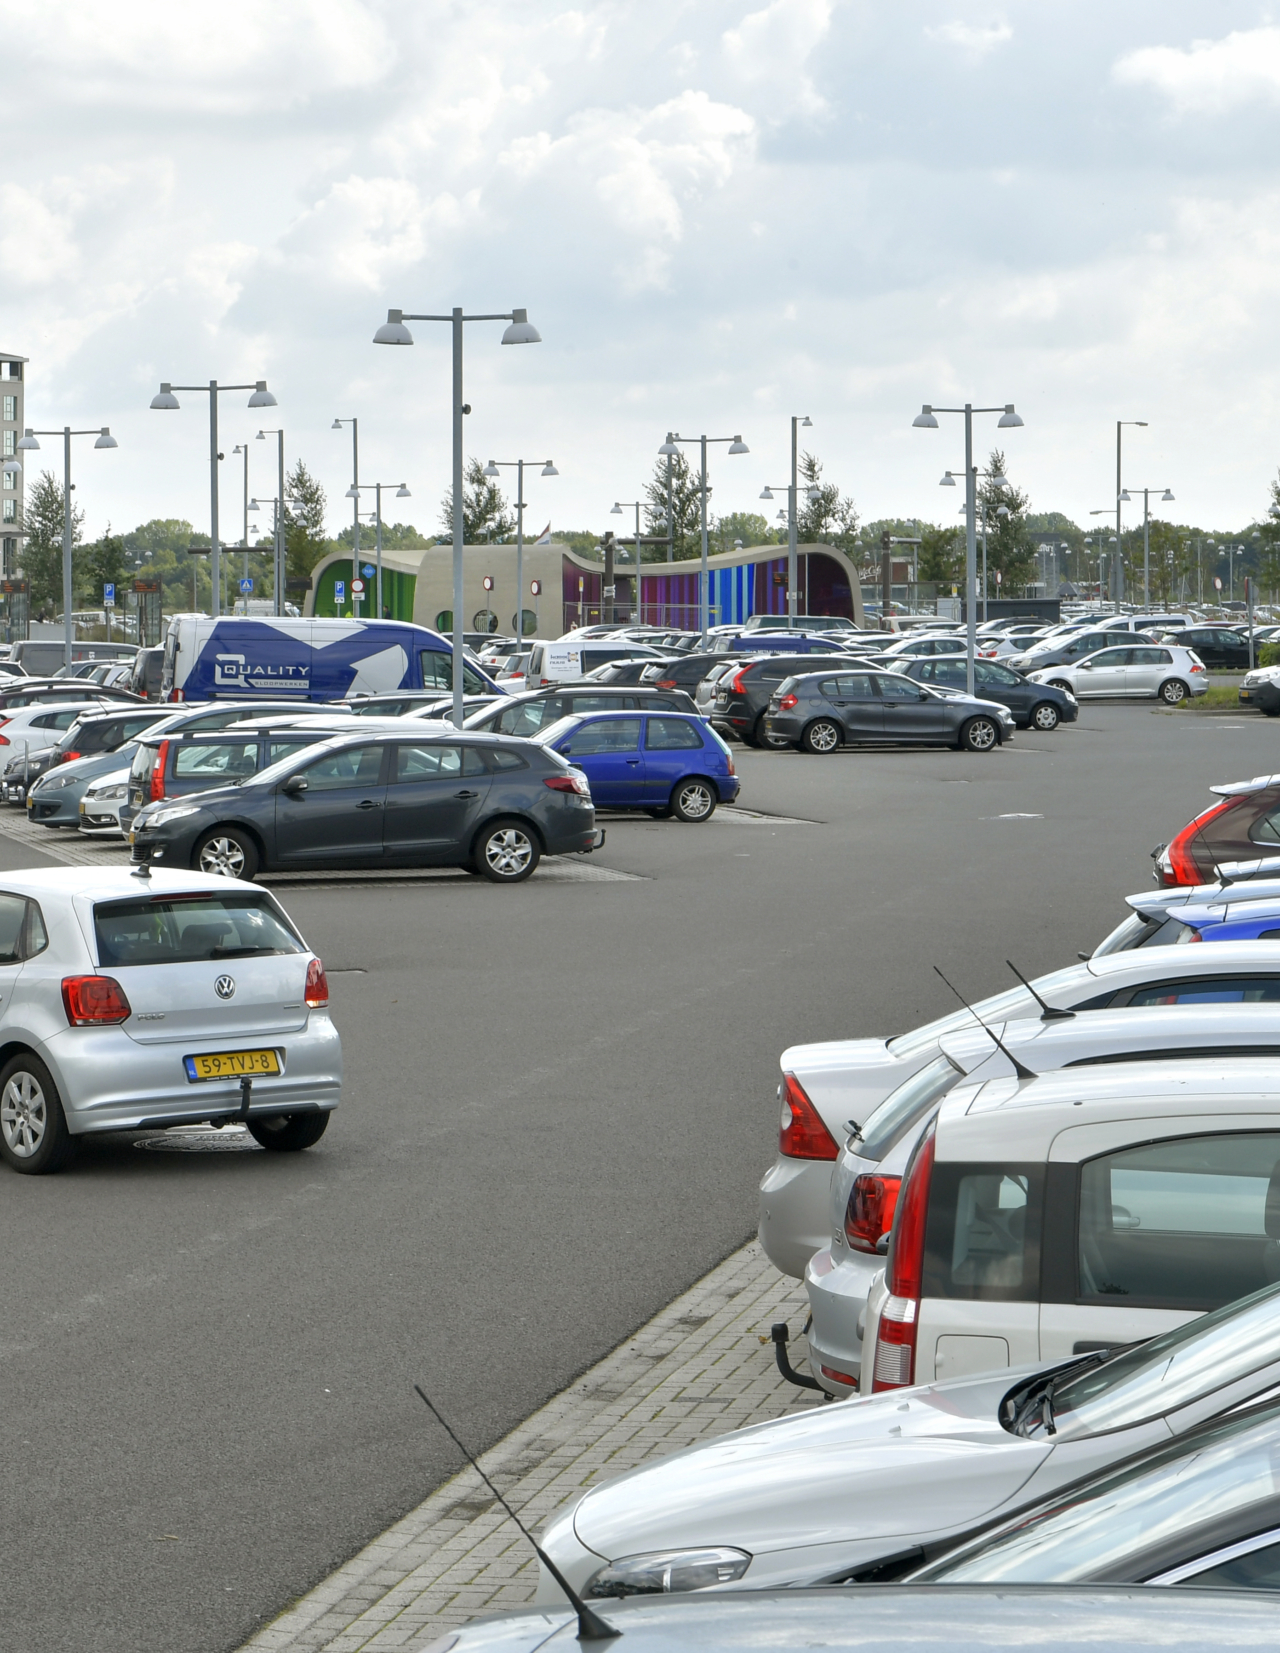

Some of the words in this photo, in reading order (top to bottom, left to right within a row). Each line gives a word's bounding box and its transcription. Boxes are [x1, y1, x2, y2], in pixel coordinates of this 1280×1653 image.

[106, 585, 112, 594] P
[336, 582, 342, 591] P
[224, 665, 310, 676] QUALITY
[137, 1013, 166, 1022] POLO
[201, 1053, 270, 1074] 59-TVJ-8
